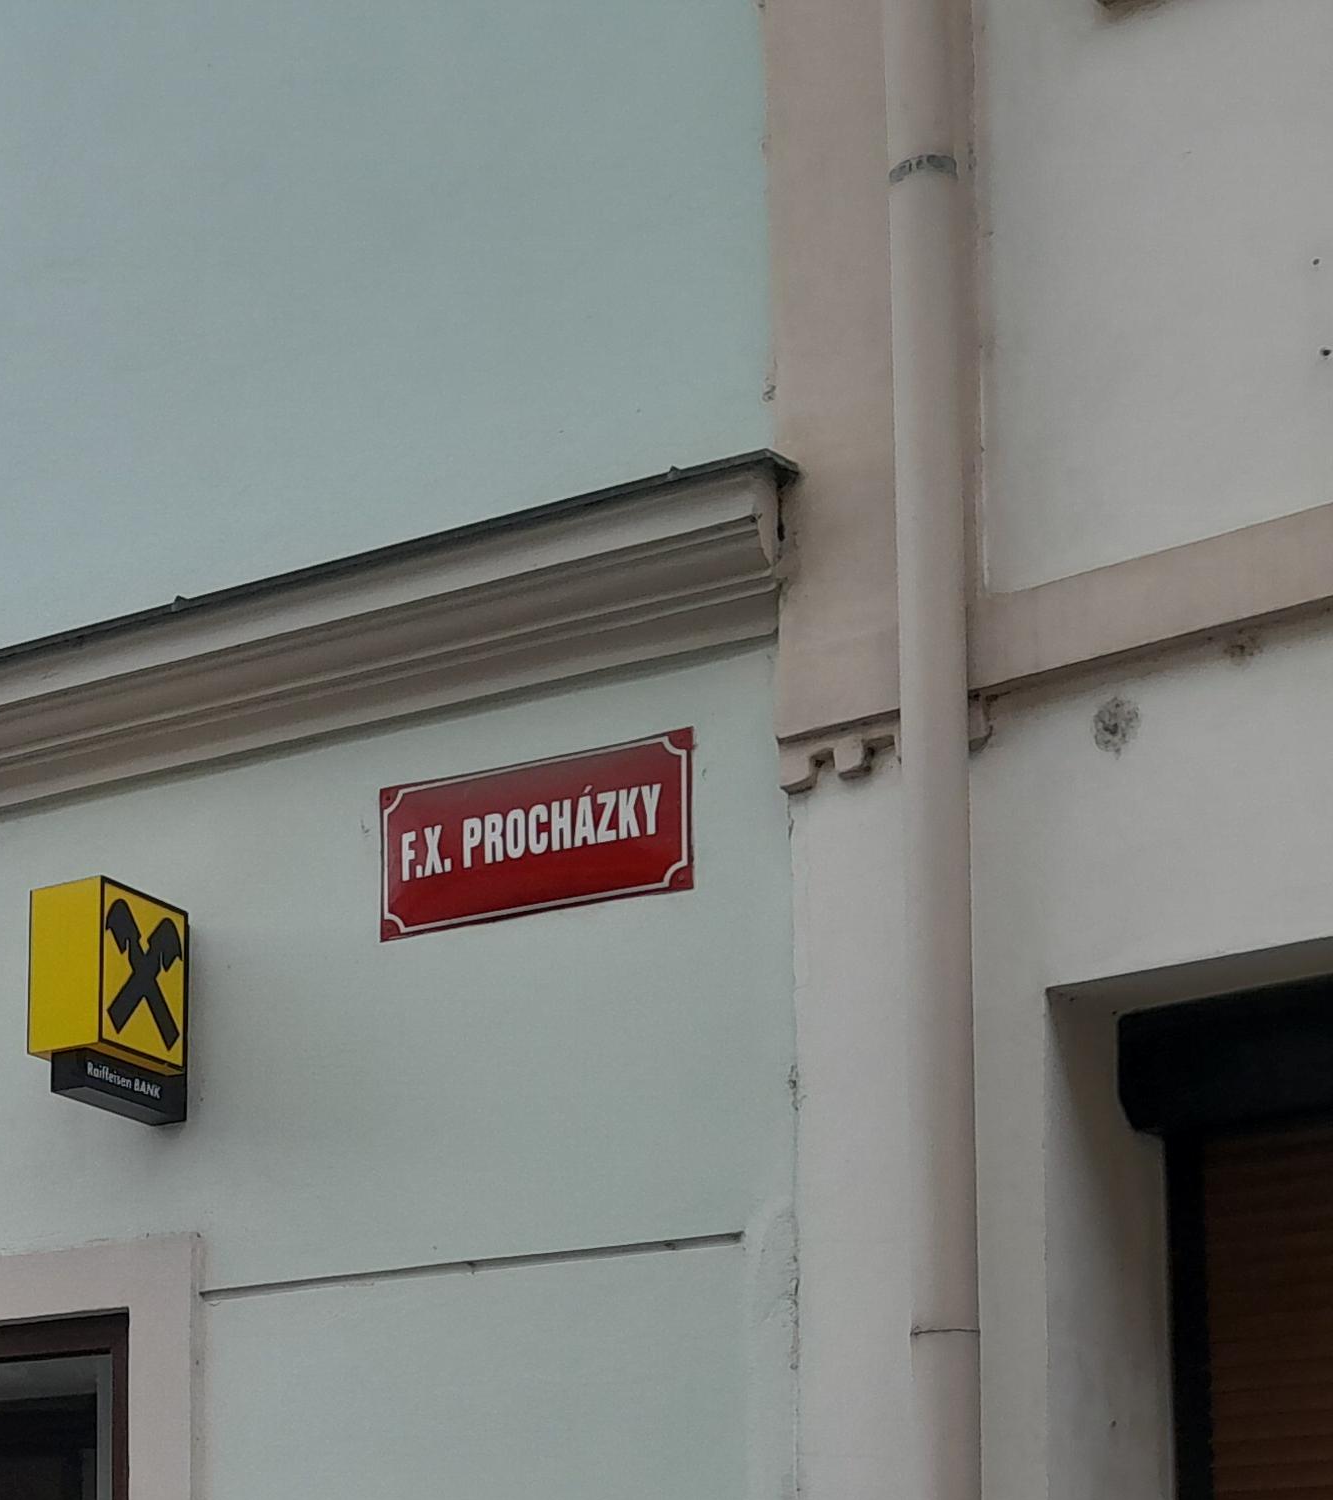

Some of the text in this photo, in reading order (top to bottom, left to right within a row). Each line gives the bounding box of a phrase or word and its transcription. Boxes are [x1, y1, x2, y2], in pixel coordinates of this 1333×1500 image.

[401, 783, 663, 882] F.X. PROCHÁZKY
[86, 1061, 162, 1099] Raiffeisen BANK
